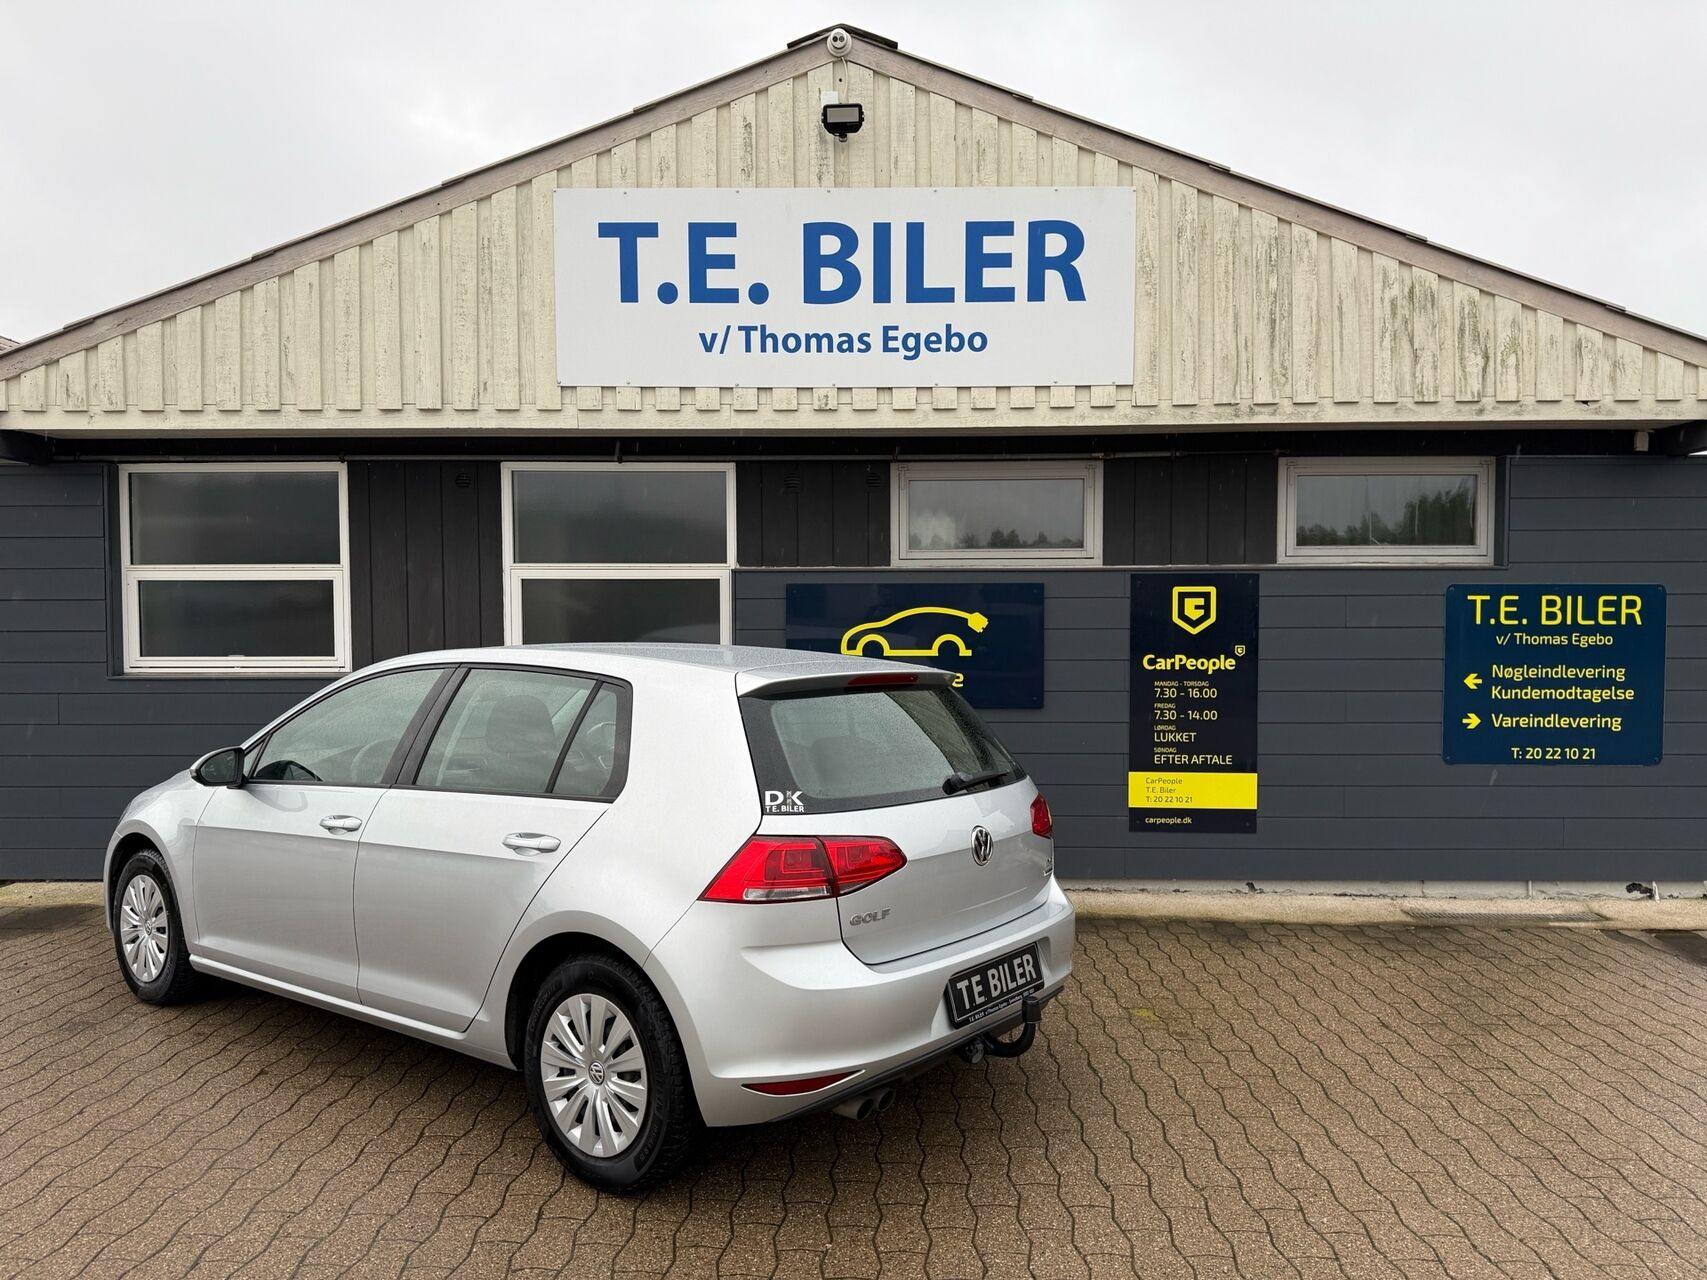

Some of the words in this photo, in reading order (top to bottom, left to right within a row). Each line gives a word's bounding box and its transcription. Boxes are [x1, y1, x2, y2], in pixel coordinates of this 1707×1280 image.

[598, 222, 770, 304] T.E.
[803, 220, 1087, 304] BILER
[699, 325, 731, 355] v/
[738, 326, 871, 354] Thomas
[883, 323, 988, 360] Egebo
[1467, 595, 1528, 625] T.E.
[1541, 595, 1642, 625] BILER
[1496, 634, 1511, 645] v/
[1514, 633, 1569, 645] Thomas
[1572, 633, 1613, 648] Egebo
[1142, 654, 1236, 675] CarPeople
[1492, 665, 1626, 681] Nøgleindlevering
[1154, 688, 1177, 698] 7.30
[1188, 688, 1218, 698] 16.00
[1491, 686, 1635, 702] Kundemodtagelse
[1154, 710, 1177, 720] 7.30
[1188, 710, 1218, 720] 14.00
[1491, 714, 1622, 731] Vareindlevering
[1154, 732, 1197, 742] LUKKET
[1154, 754, 1189, 765] EFTER
[1191, 755, 1233, 765] AFTALE
[1511, 748, 1522, 759] T:
[1525, 748, 1542, 759] 20
[1545, 748, 1561, 759] 22
[1564, 748, 1579, 759] 10
[1582, 748, 1596, 759] 21
[1145, 777, 1183, 785] CarPeople
[780, 804, 805, 813] BILER
[1145, 816, 1193, 825] carpeople.dk
[850, 907, 891, 926] GOLF
[987, 953, 1037, 998] BILER
